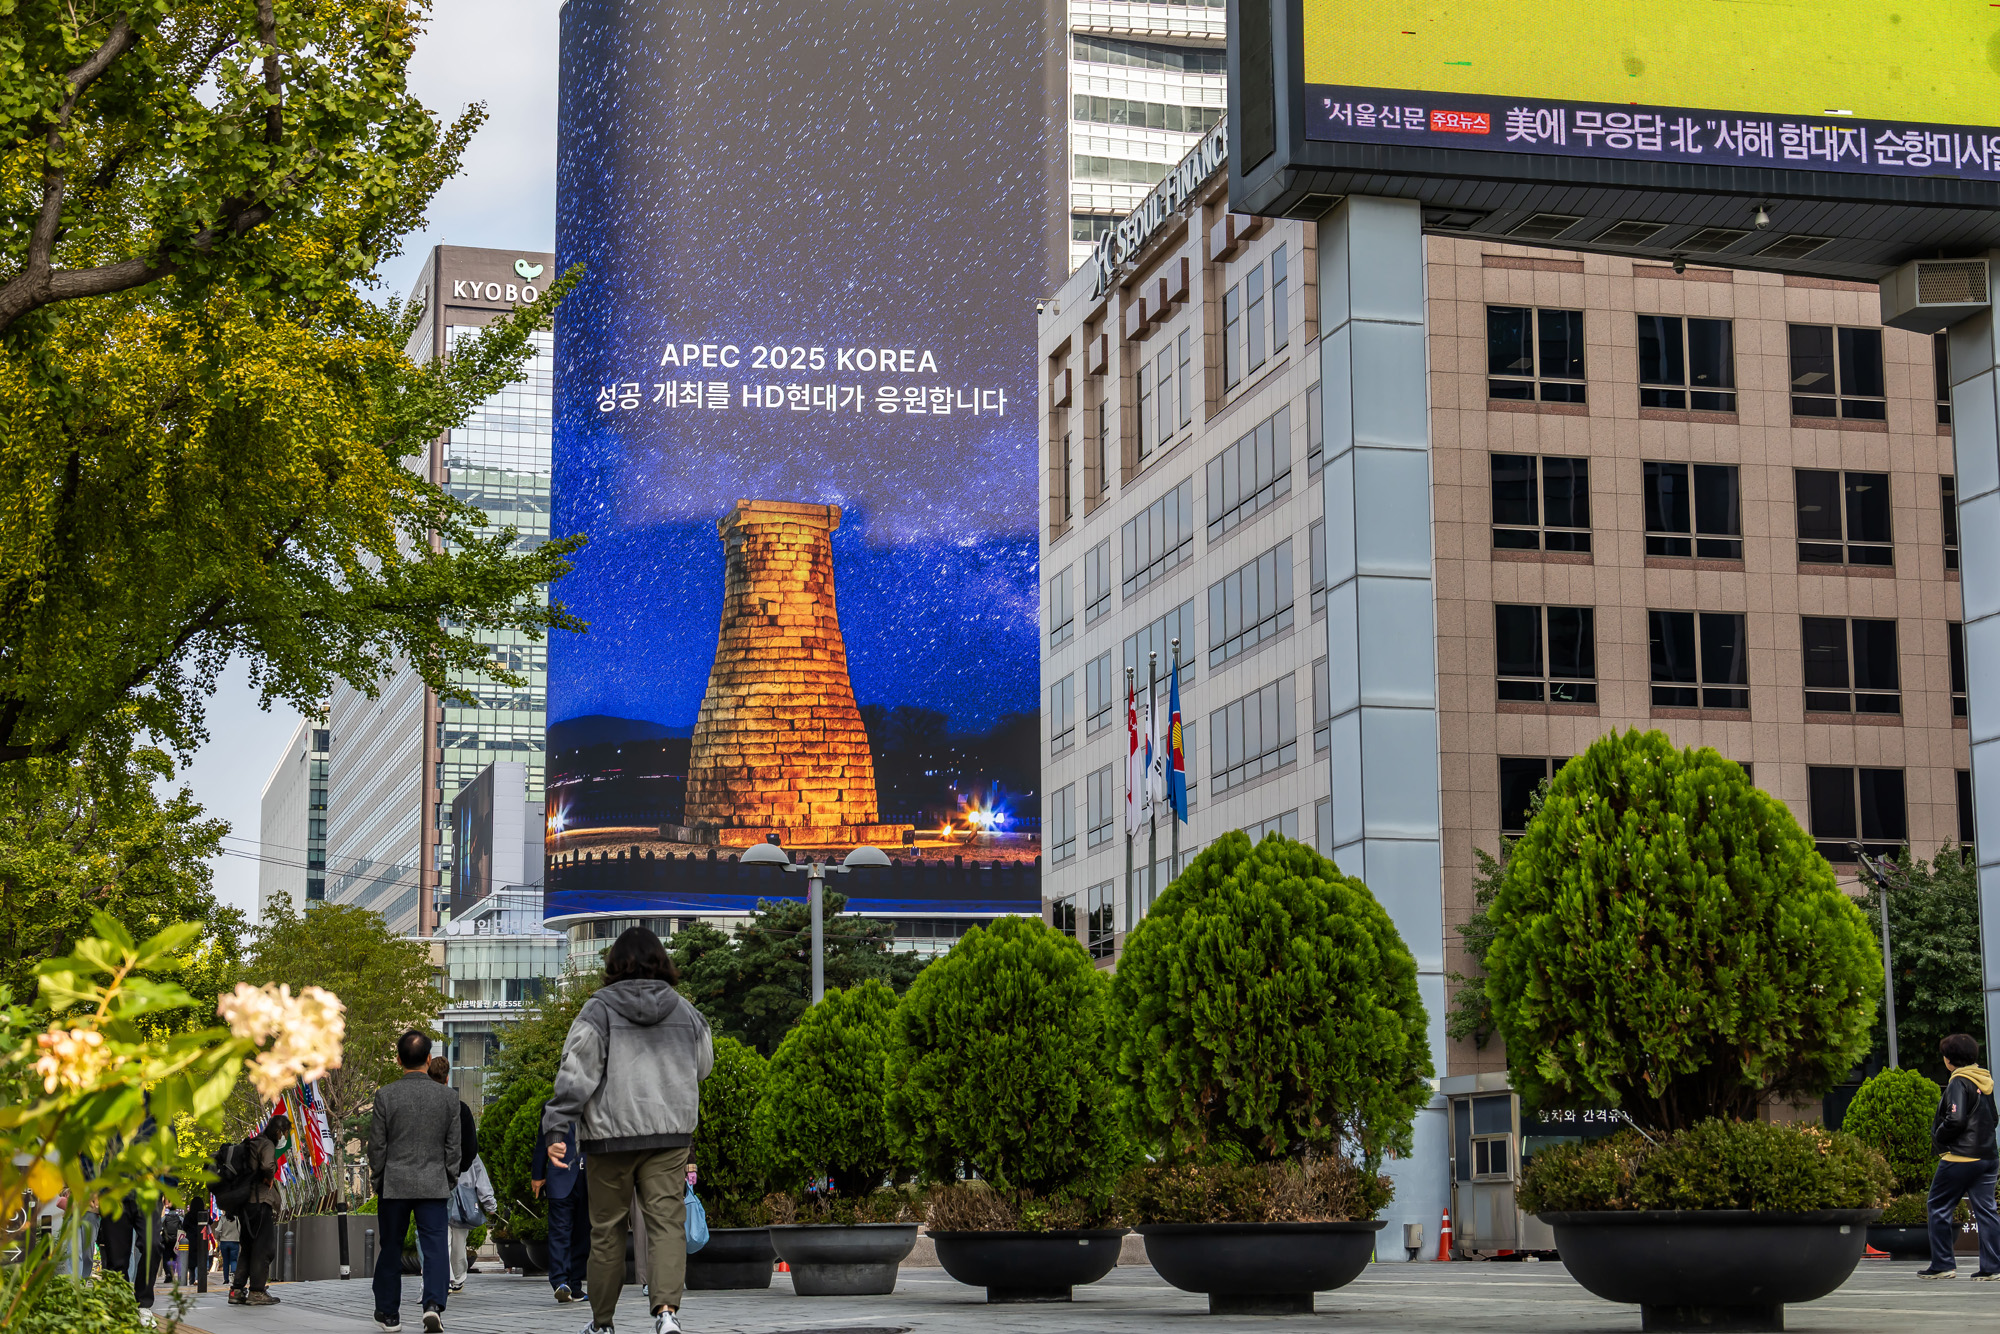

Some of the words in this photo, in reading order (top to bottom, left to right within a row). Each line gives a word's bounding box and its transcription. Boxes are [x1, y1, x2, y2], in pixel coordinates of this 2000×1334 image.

[1432, 112, 1488, 130] 주요뉴스
[1504, 106, 1567, 146] 美에
[1572, 111, 1666, 151] 무응답
[1670, 117, 1703, 153] 北
[1706, 120, 1774, 158] "서해
[1778, 123, 1868, 164] 함대지
[1116, 193, 1166, 265] SEOUL
[454, 279, 538, 304] KYOBO
[660, 343, 741, 368] APEC
[751, 345, 826, 371] 2025
[836, 347, 938, 373] KOREA
[596, 382, 642, 412] 성공
[652, 380, 731, 411] 개최를
[742, 383, 865, 413] HD현대가
[875, 386, 1008, 416] 응원합니다
